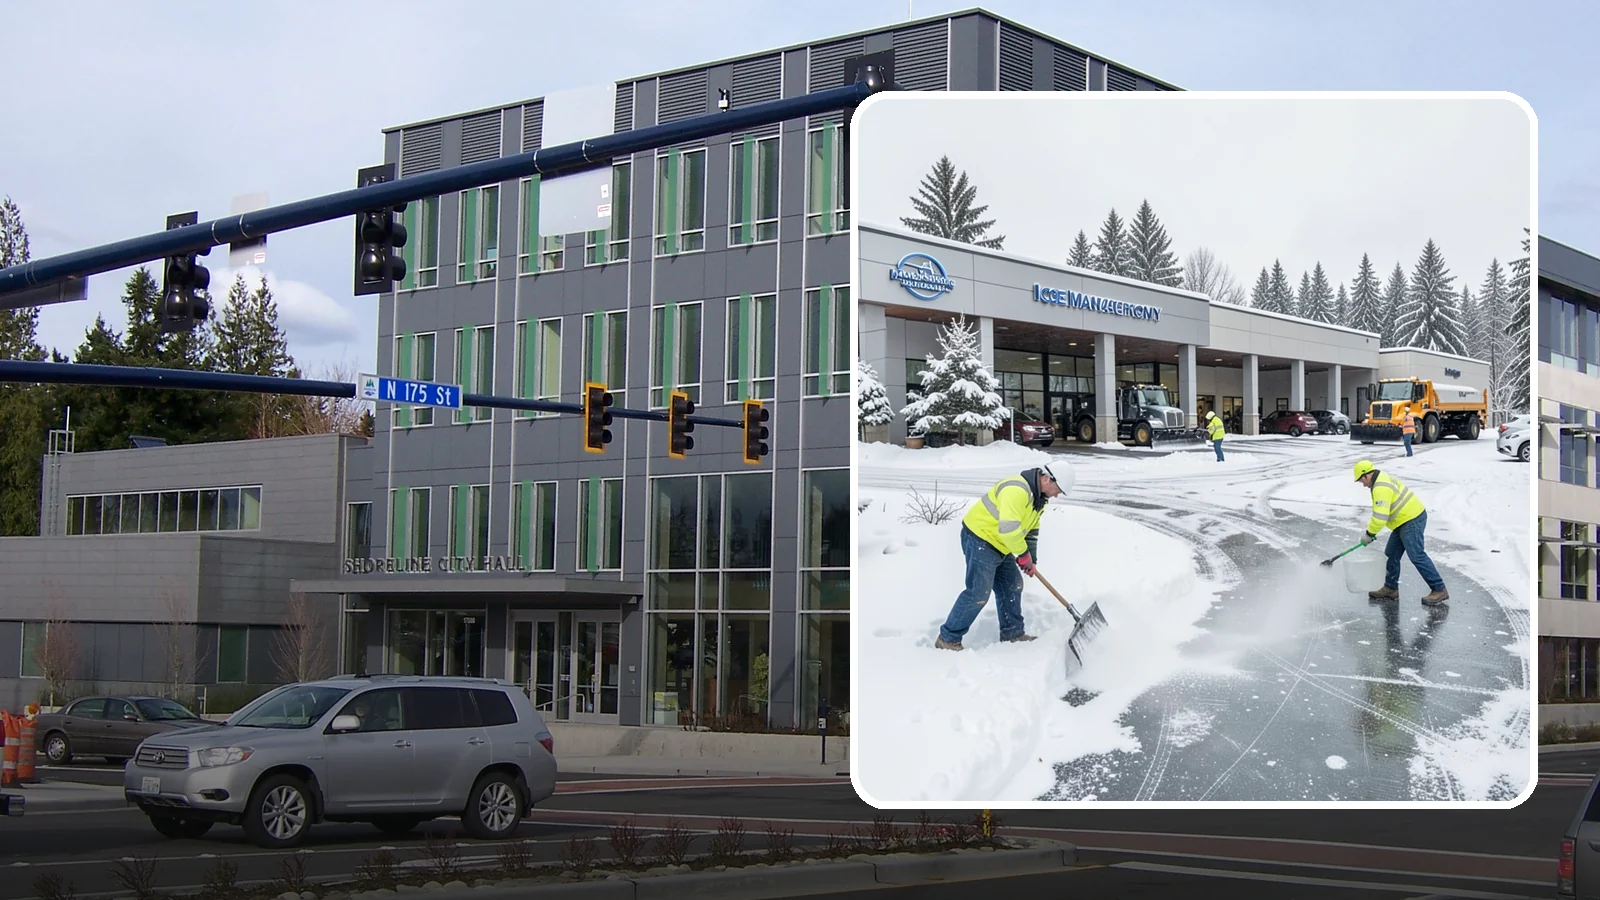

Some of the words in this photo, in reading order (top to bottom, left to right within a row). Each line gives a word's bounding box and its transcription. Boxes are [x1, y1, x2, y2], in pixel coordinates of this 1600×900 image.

[387, 380, 396, 400] N
[405, 382, 428, 403] 175
[436, 386, 452, 406] St
[344, 556, 432, 574] SHORELINE
[438, 556, 475, 573] CITY
[483, 555, 526, 573] HALL
